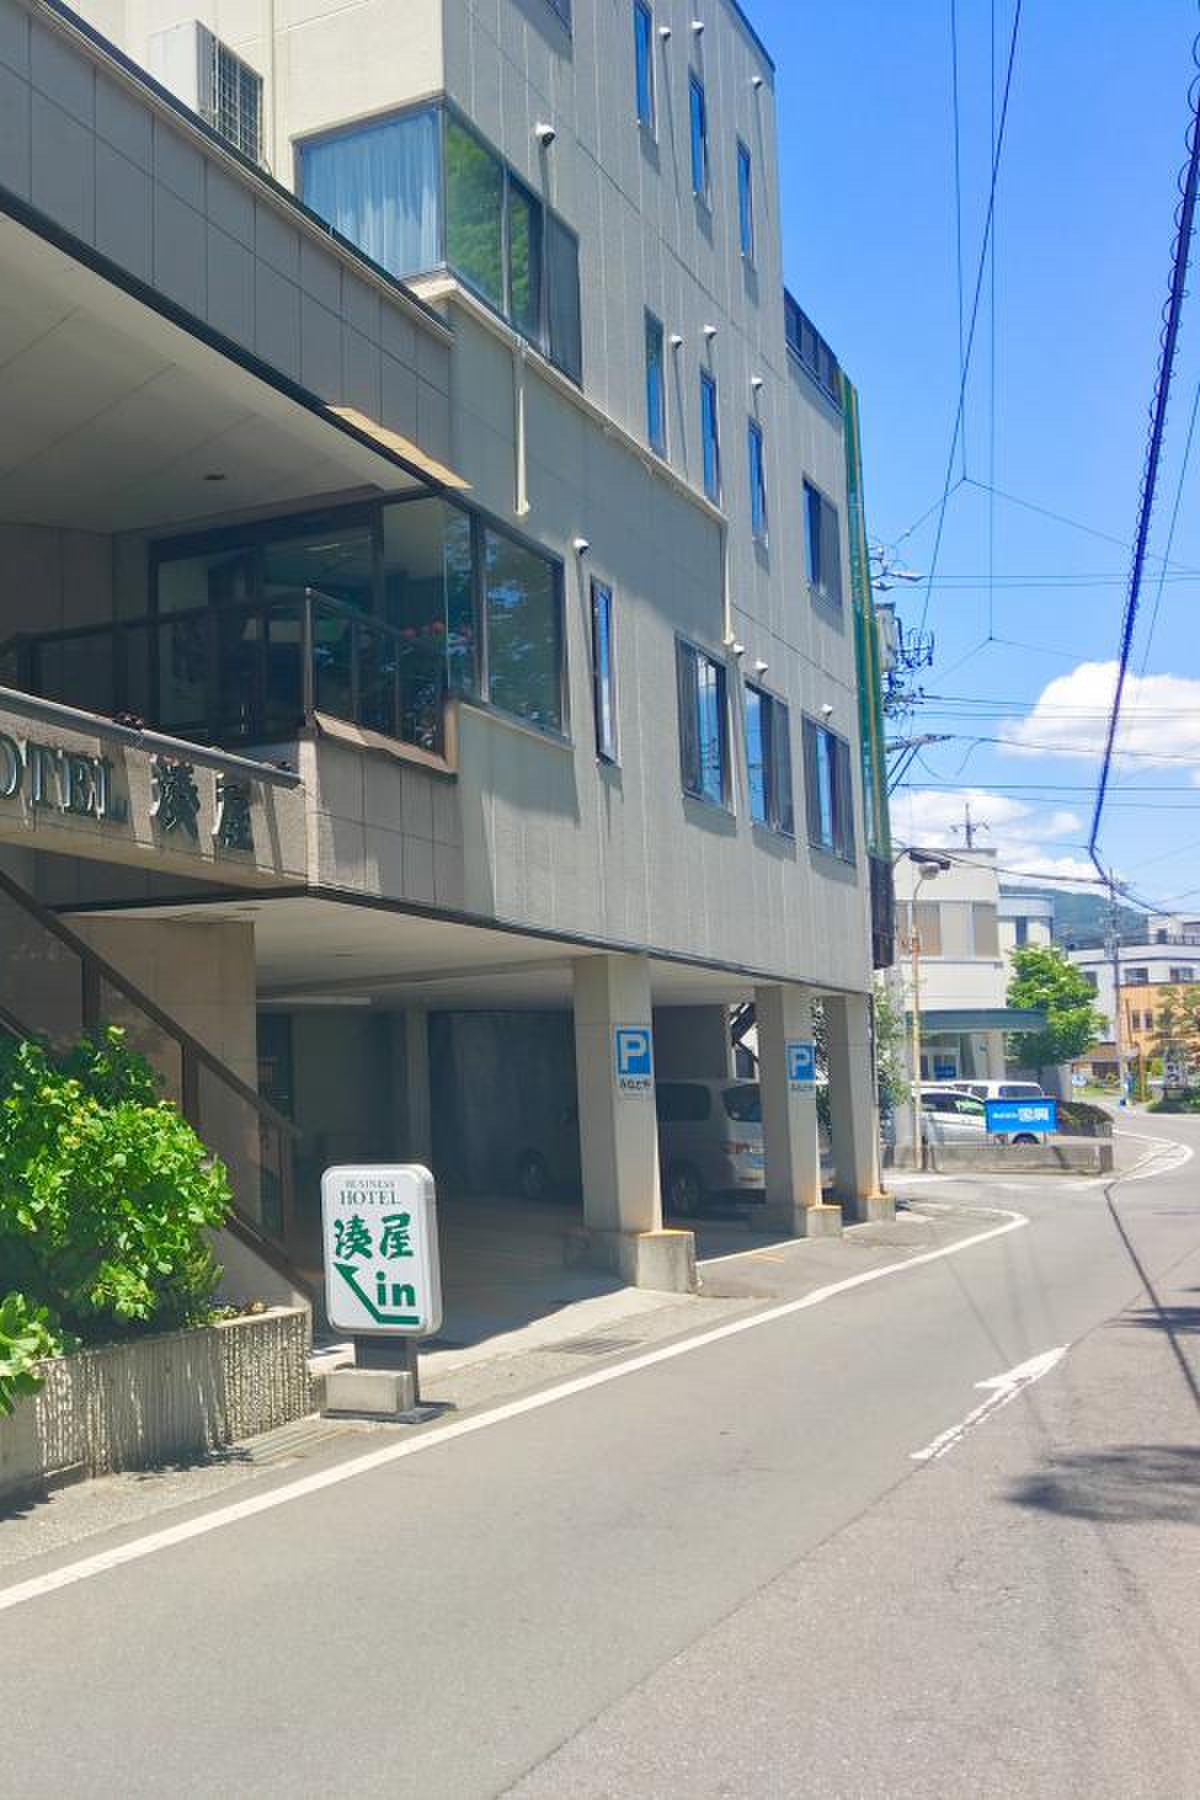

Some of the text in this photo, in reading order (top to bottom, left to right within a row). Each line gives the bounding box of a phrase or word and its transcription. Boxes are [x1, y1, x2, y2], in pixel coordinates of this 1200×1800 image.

[620, 1033, 647, 1073] P
[340, 1190, 401, 1205] HOTEL
[345, 1179, 395, 1188] BUSINESS
[334, 1212, 414, 1260] 湊屋
[376, 1271, 416, 1306] in
